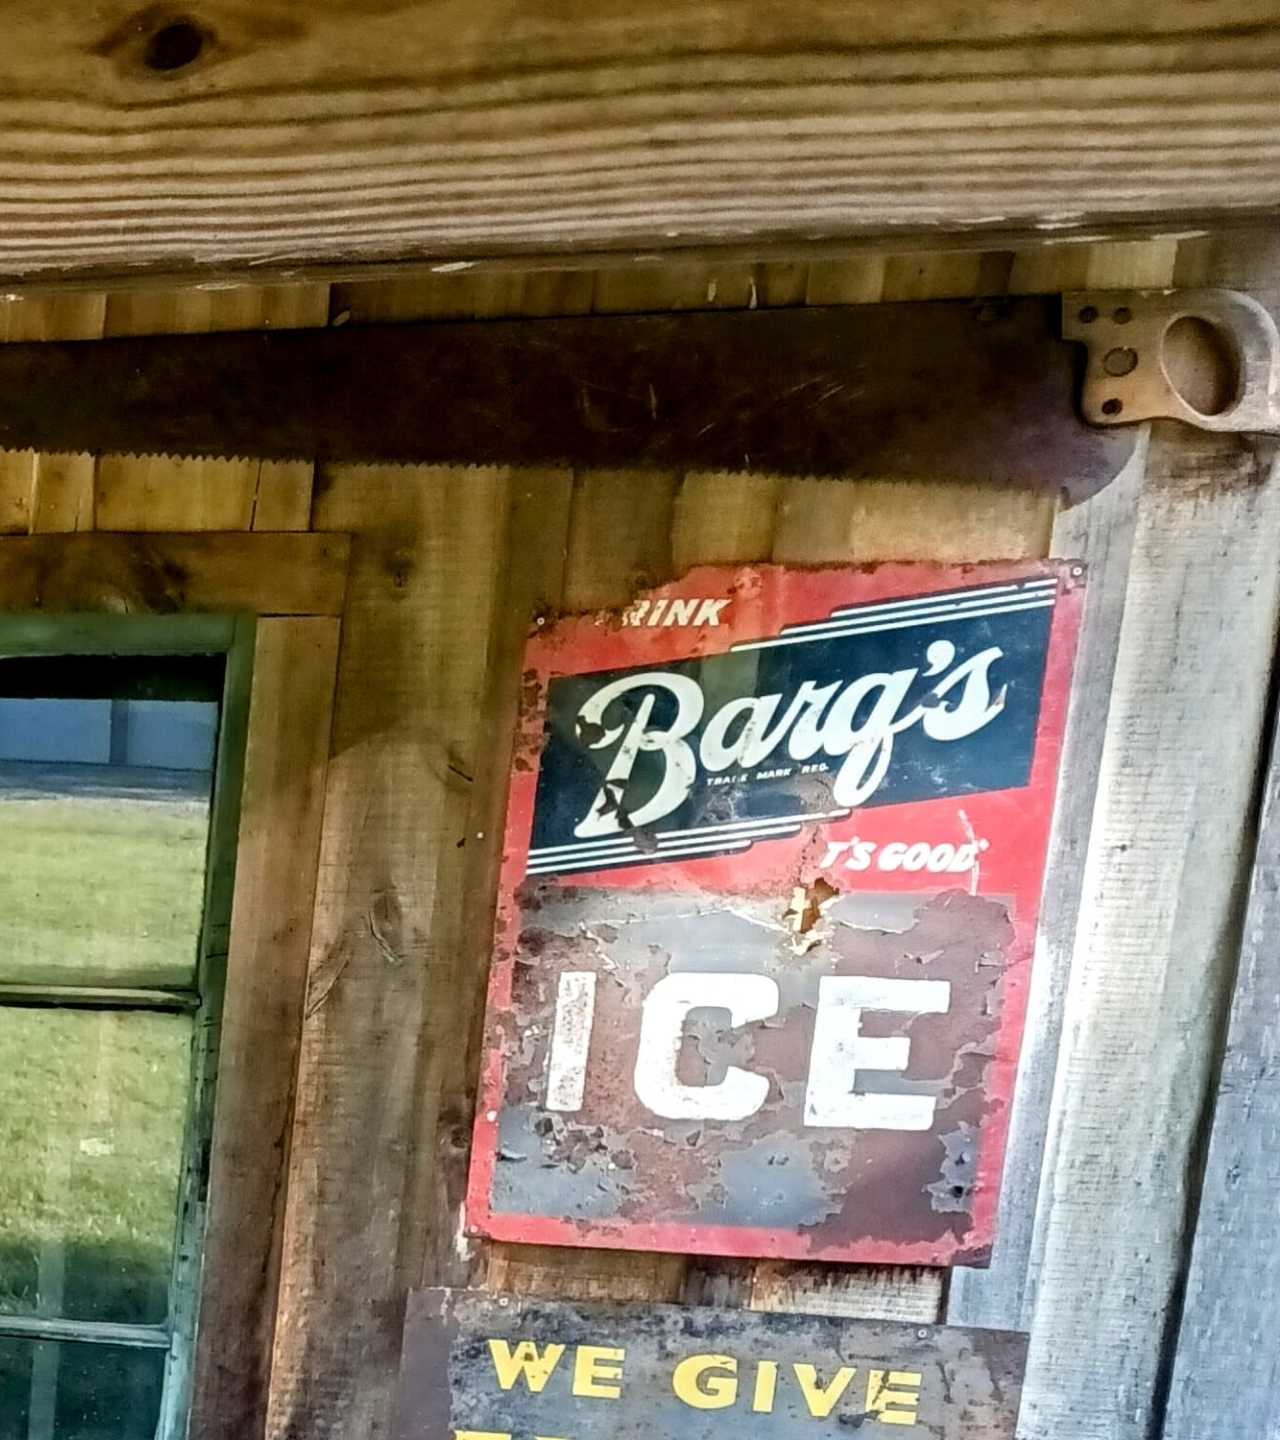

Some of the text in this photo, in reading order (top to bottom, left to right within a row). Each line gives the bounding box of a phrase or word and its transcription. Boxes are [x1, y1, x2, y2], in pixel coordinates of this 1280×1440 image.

[621, 598, 732, 627] RINK
[756, 768, 792, 780] MARK
[819, 836, 877, 872] T'S
[545, 971, 951, 1131] ICE
[488, 1339, 922, 1426] WE GIVE
